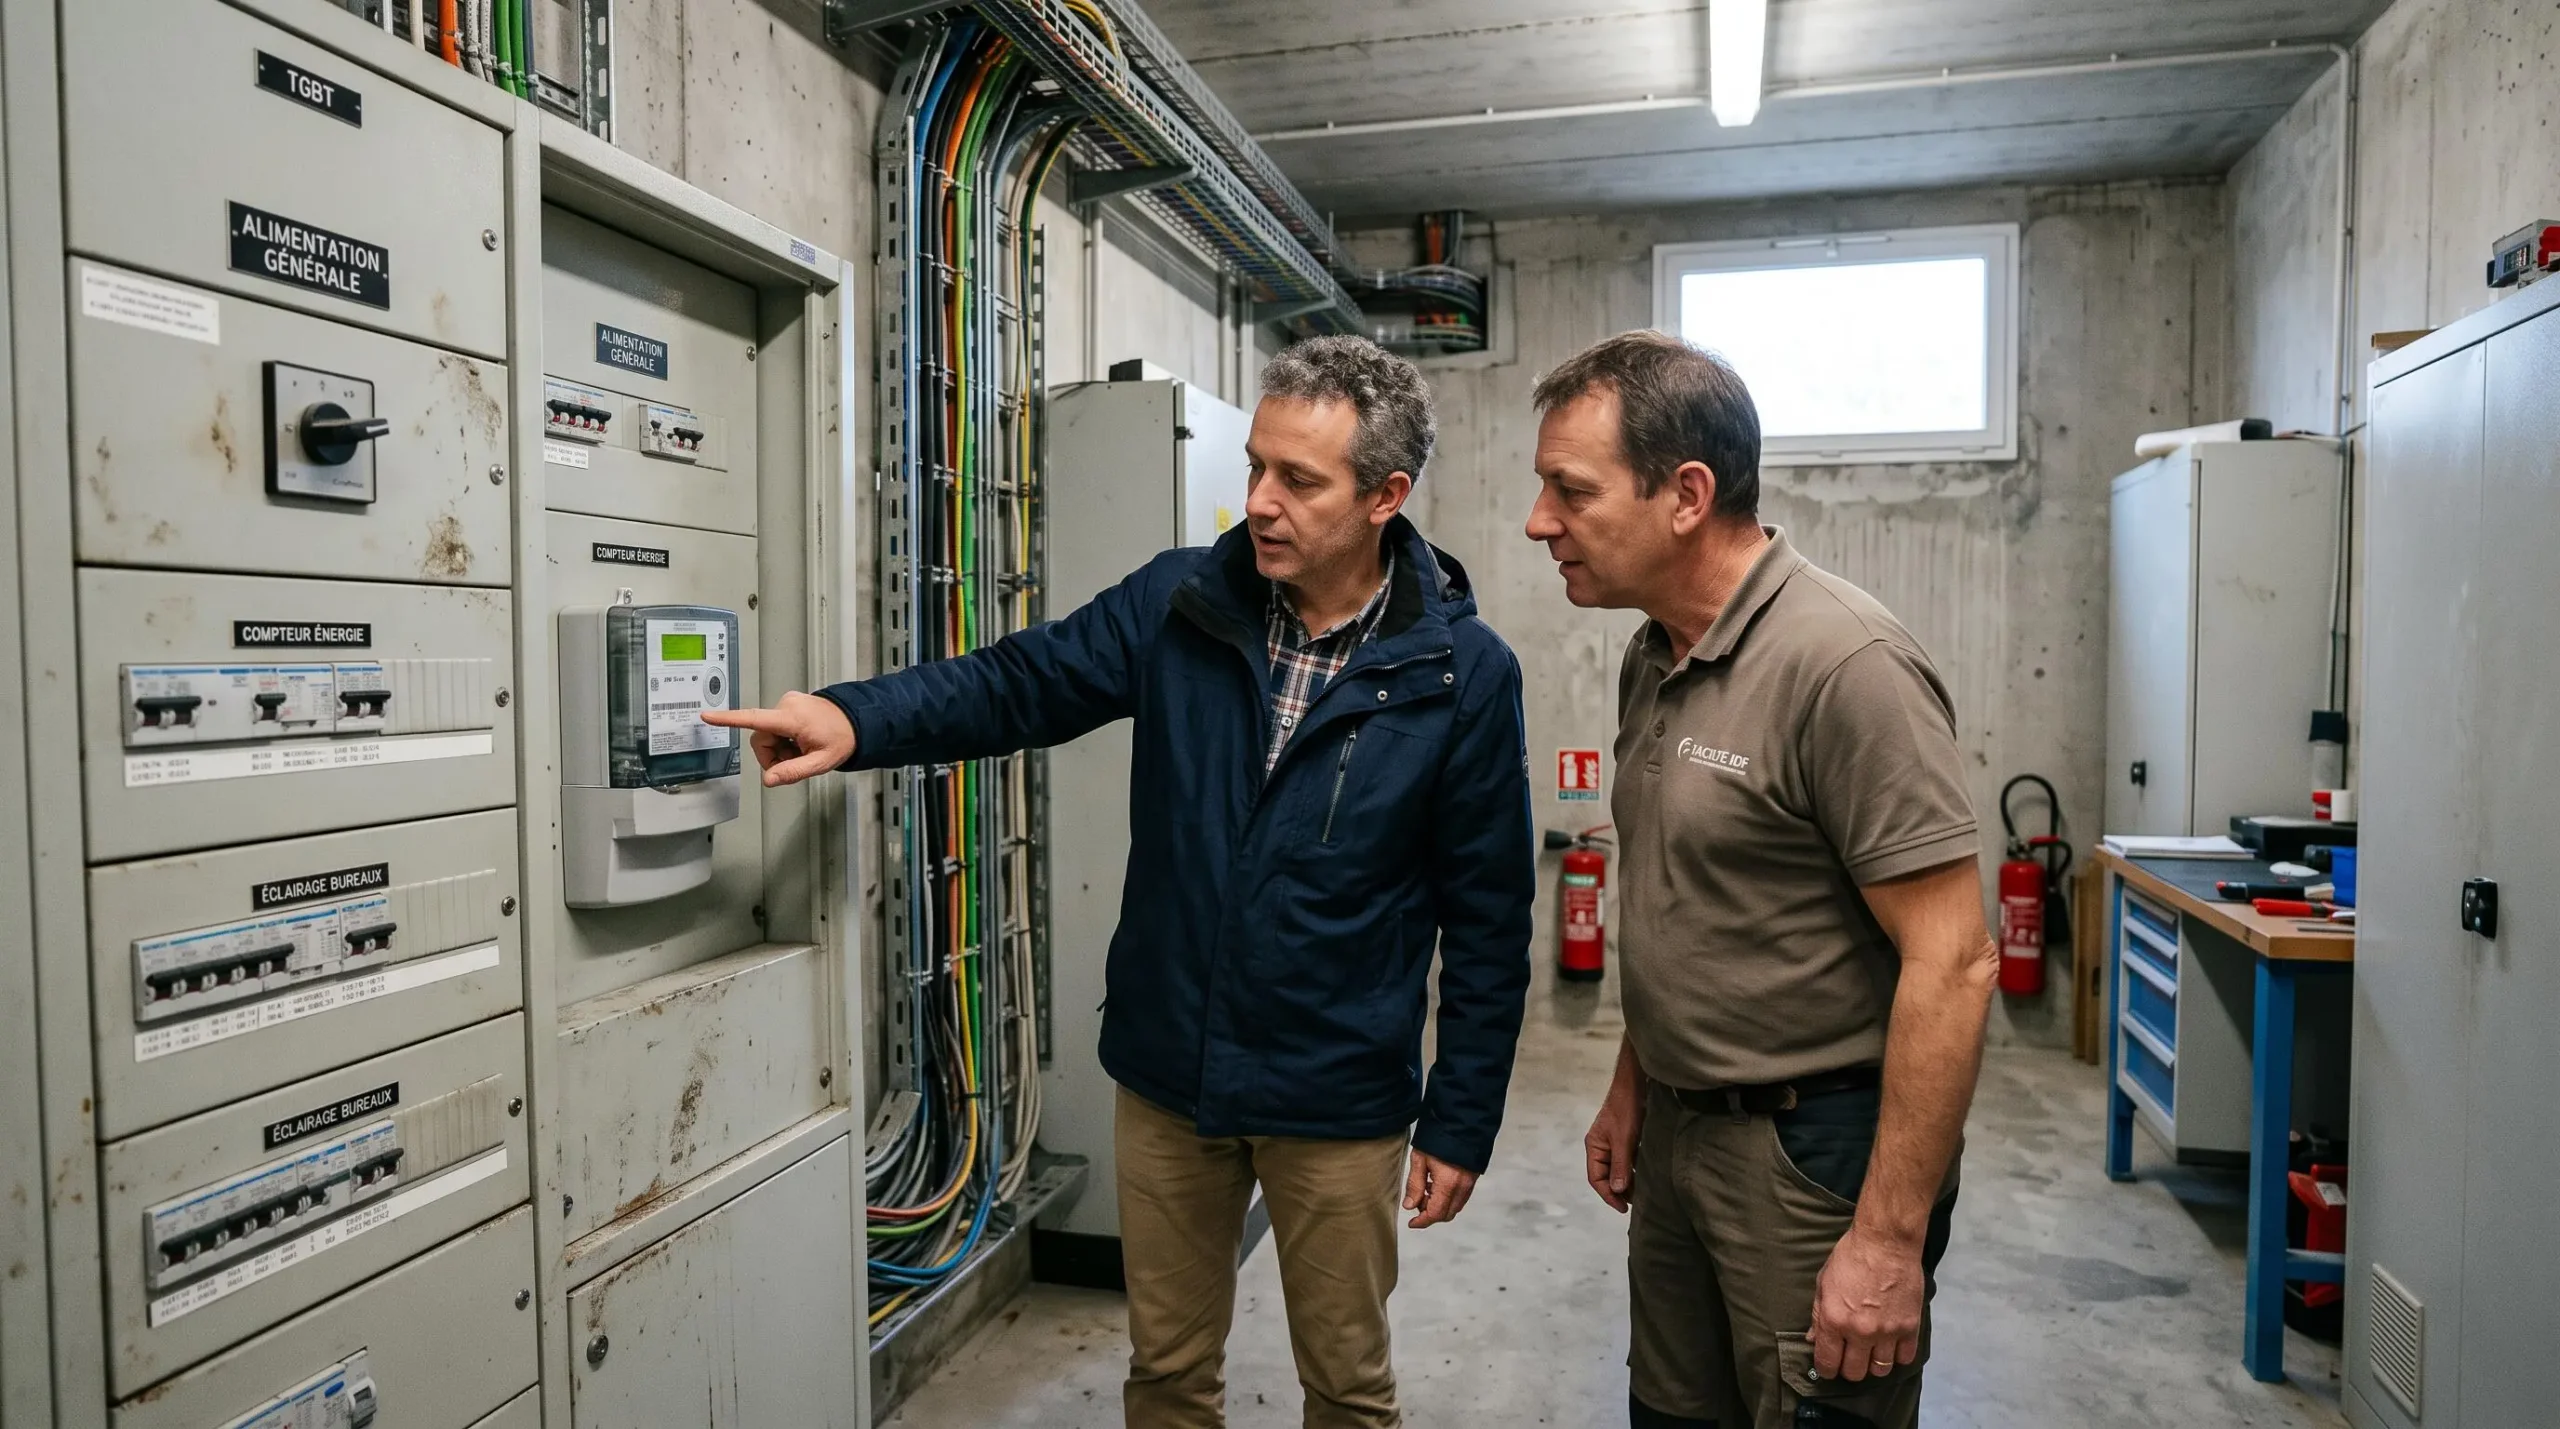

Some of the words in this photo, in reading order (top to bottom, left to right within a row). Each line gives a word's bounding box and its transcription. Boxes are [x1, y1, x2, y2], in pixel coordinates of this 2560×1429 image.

[287, 69, 335, 108] TGBT
[242, 213, 380, 272] ALIMENTATION
[264, 247, 361, 294] GÉNÉRALE
[601, 329, 663, 358] ALIMENTATION
[596, 546, 636, 561] COMPTEUR
[242, 626, 311, 642] COMPTEUR
[314, 623, 364, 642] ÉNERGIE
[1728, 753, 1750, 769] IDF
[261, 878, 327, 903] ÉCLAIRAGE
[330, 869, 382, 891] BUREAUX
[272, 1107, 337, 1143] ÉCLAIRAGE
[341, 1088, 392, 1118] BUREAUX
